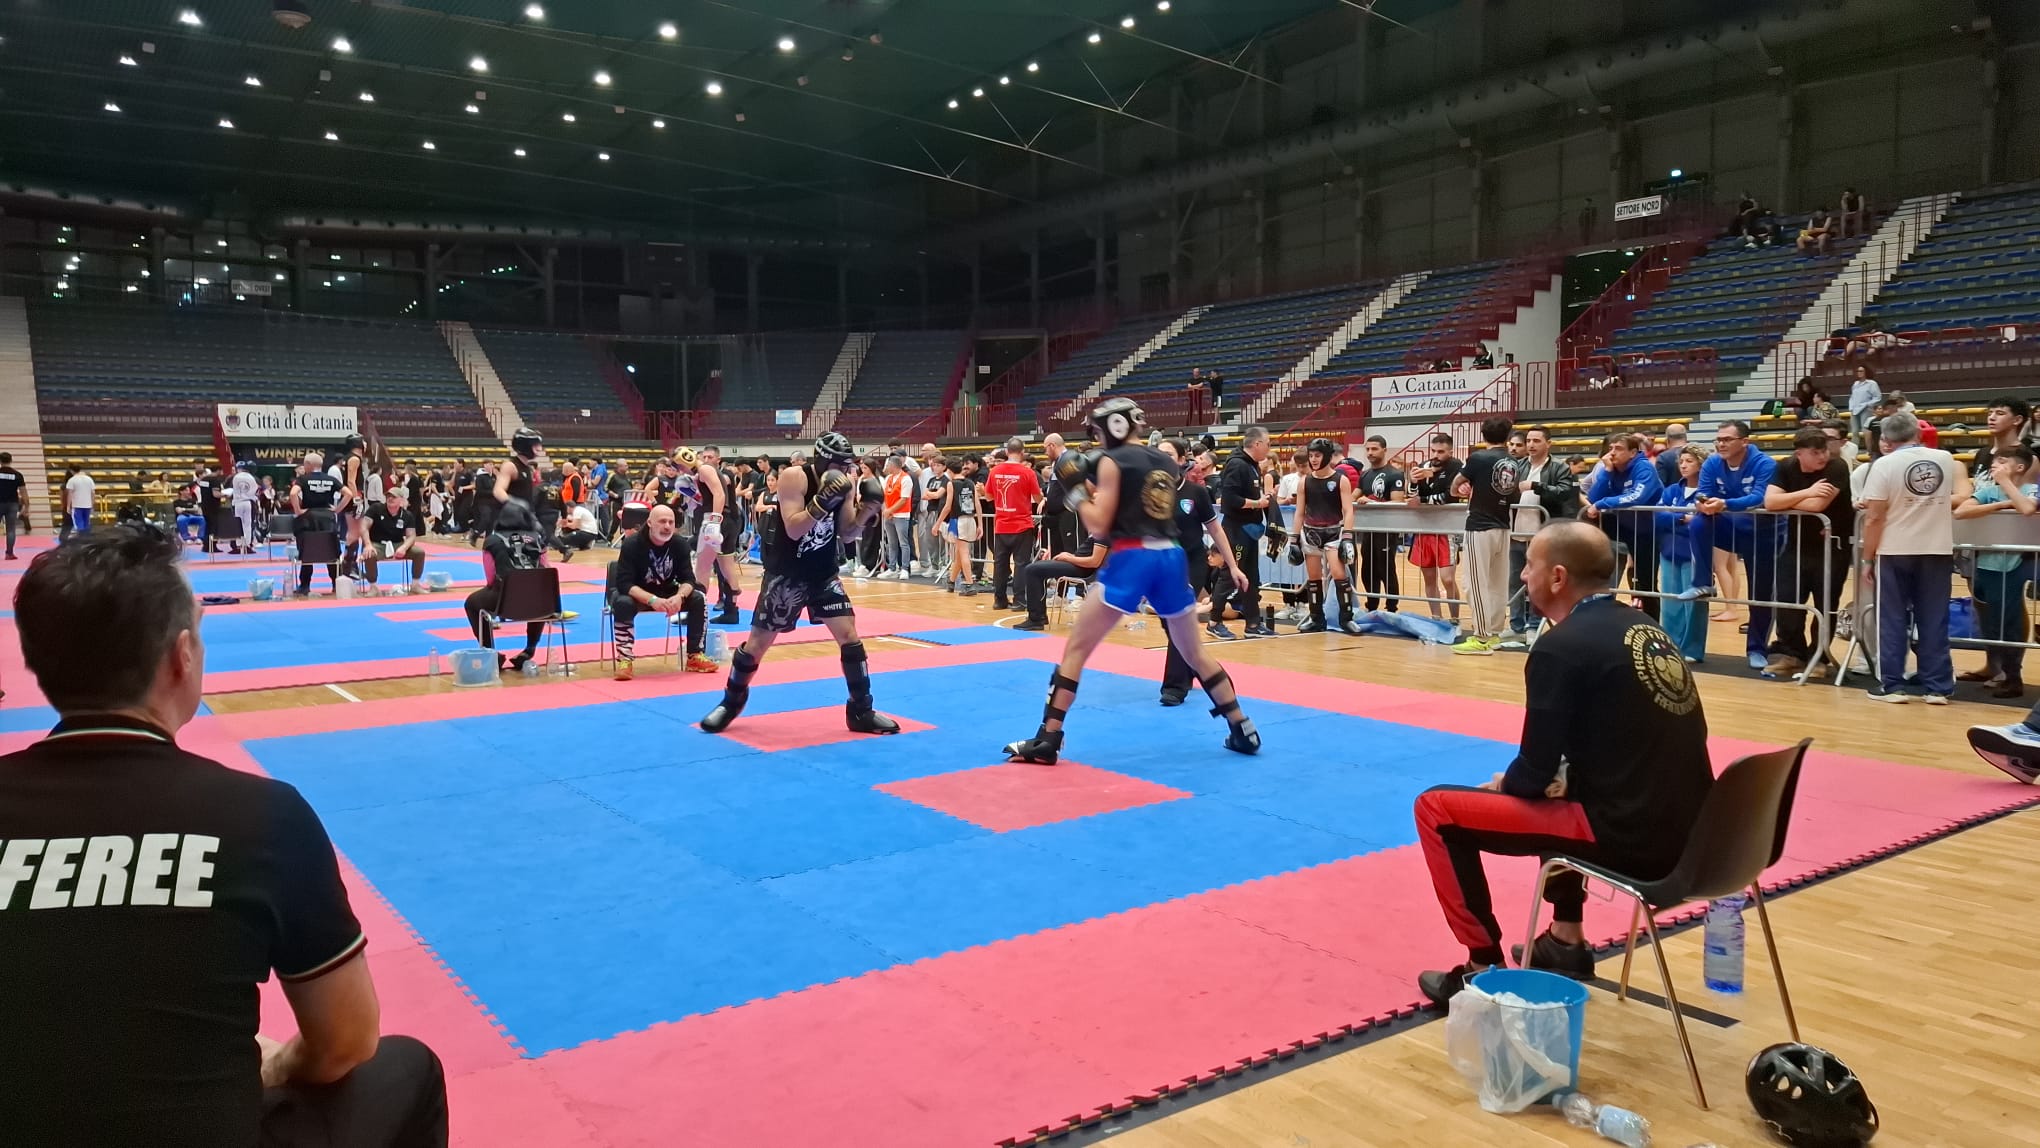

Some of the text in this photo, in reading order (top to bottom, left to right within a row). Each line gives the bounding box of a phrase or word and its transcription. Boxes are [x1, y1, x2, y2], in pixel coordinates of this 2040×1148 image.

[1616, 200, 1660, 216] SETTORE NORD
[1388, 374, 1467, 394] A Catania
[1378, 396, 1476, 414] Lo Sport è Inclusione
[245, 411, 353, 431] Città di Catania
[822, 602, 842, 611] WHITE
[0, 834, 220, 910] FEREE
